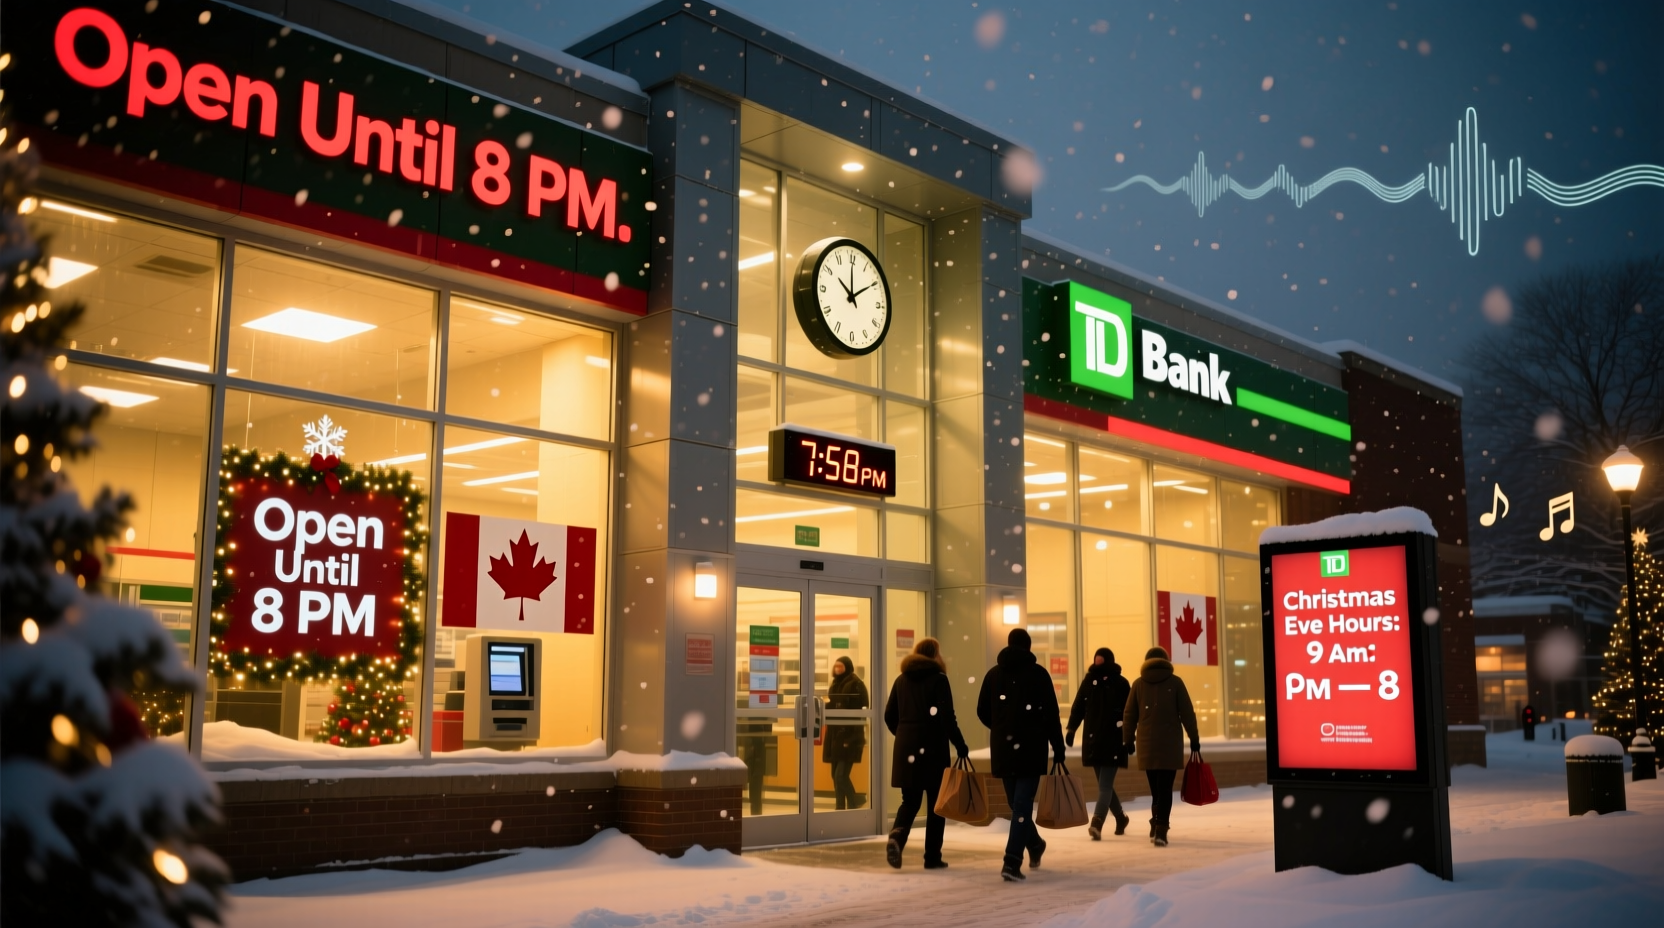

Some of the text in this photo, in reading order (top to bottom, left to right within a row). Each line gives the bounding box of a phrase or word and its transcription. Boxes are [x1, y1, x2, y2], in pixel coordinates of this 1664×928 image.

[54, 7, 632, 243] Open Until 8 PM.
[1074, 300, 1232, 405] TD Bank
[254, 497, 384, 554] Open
[275, 549, 359, 587] Until
[1322, 555, 1346, 574] TD
[251, 587, 376, 637] 8 PM
[1283, 588, 1396, 611] Christmas
[1284, 614, 1400, 636] Eve Hours:
[1306, 640, 1324, 664] 9
[1378, 670, 1400, 700] 8
